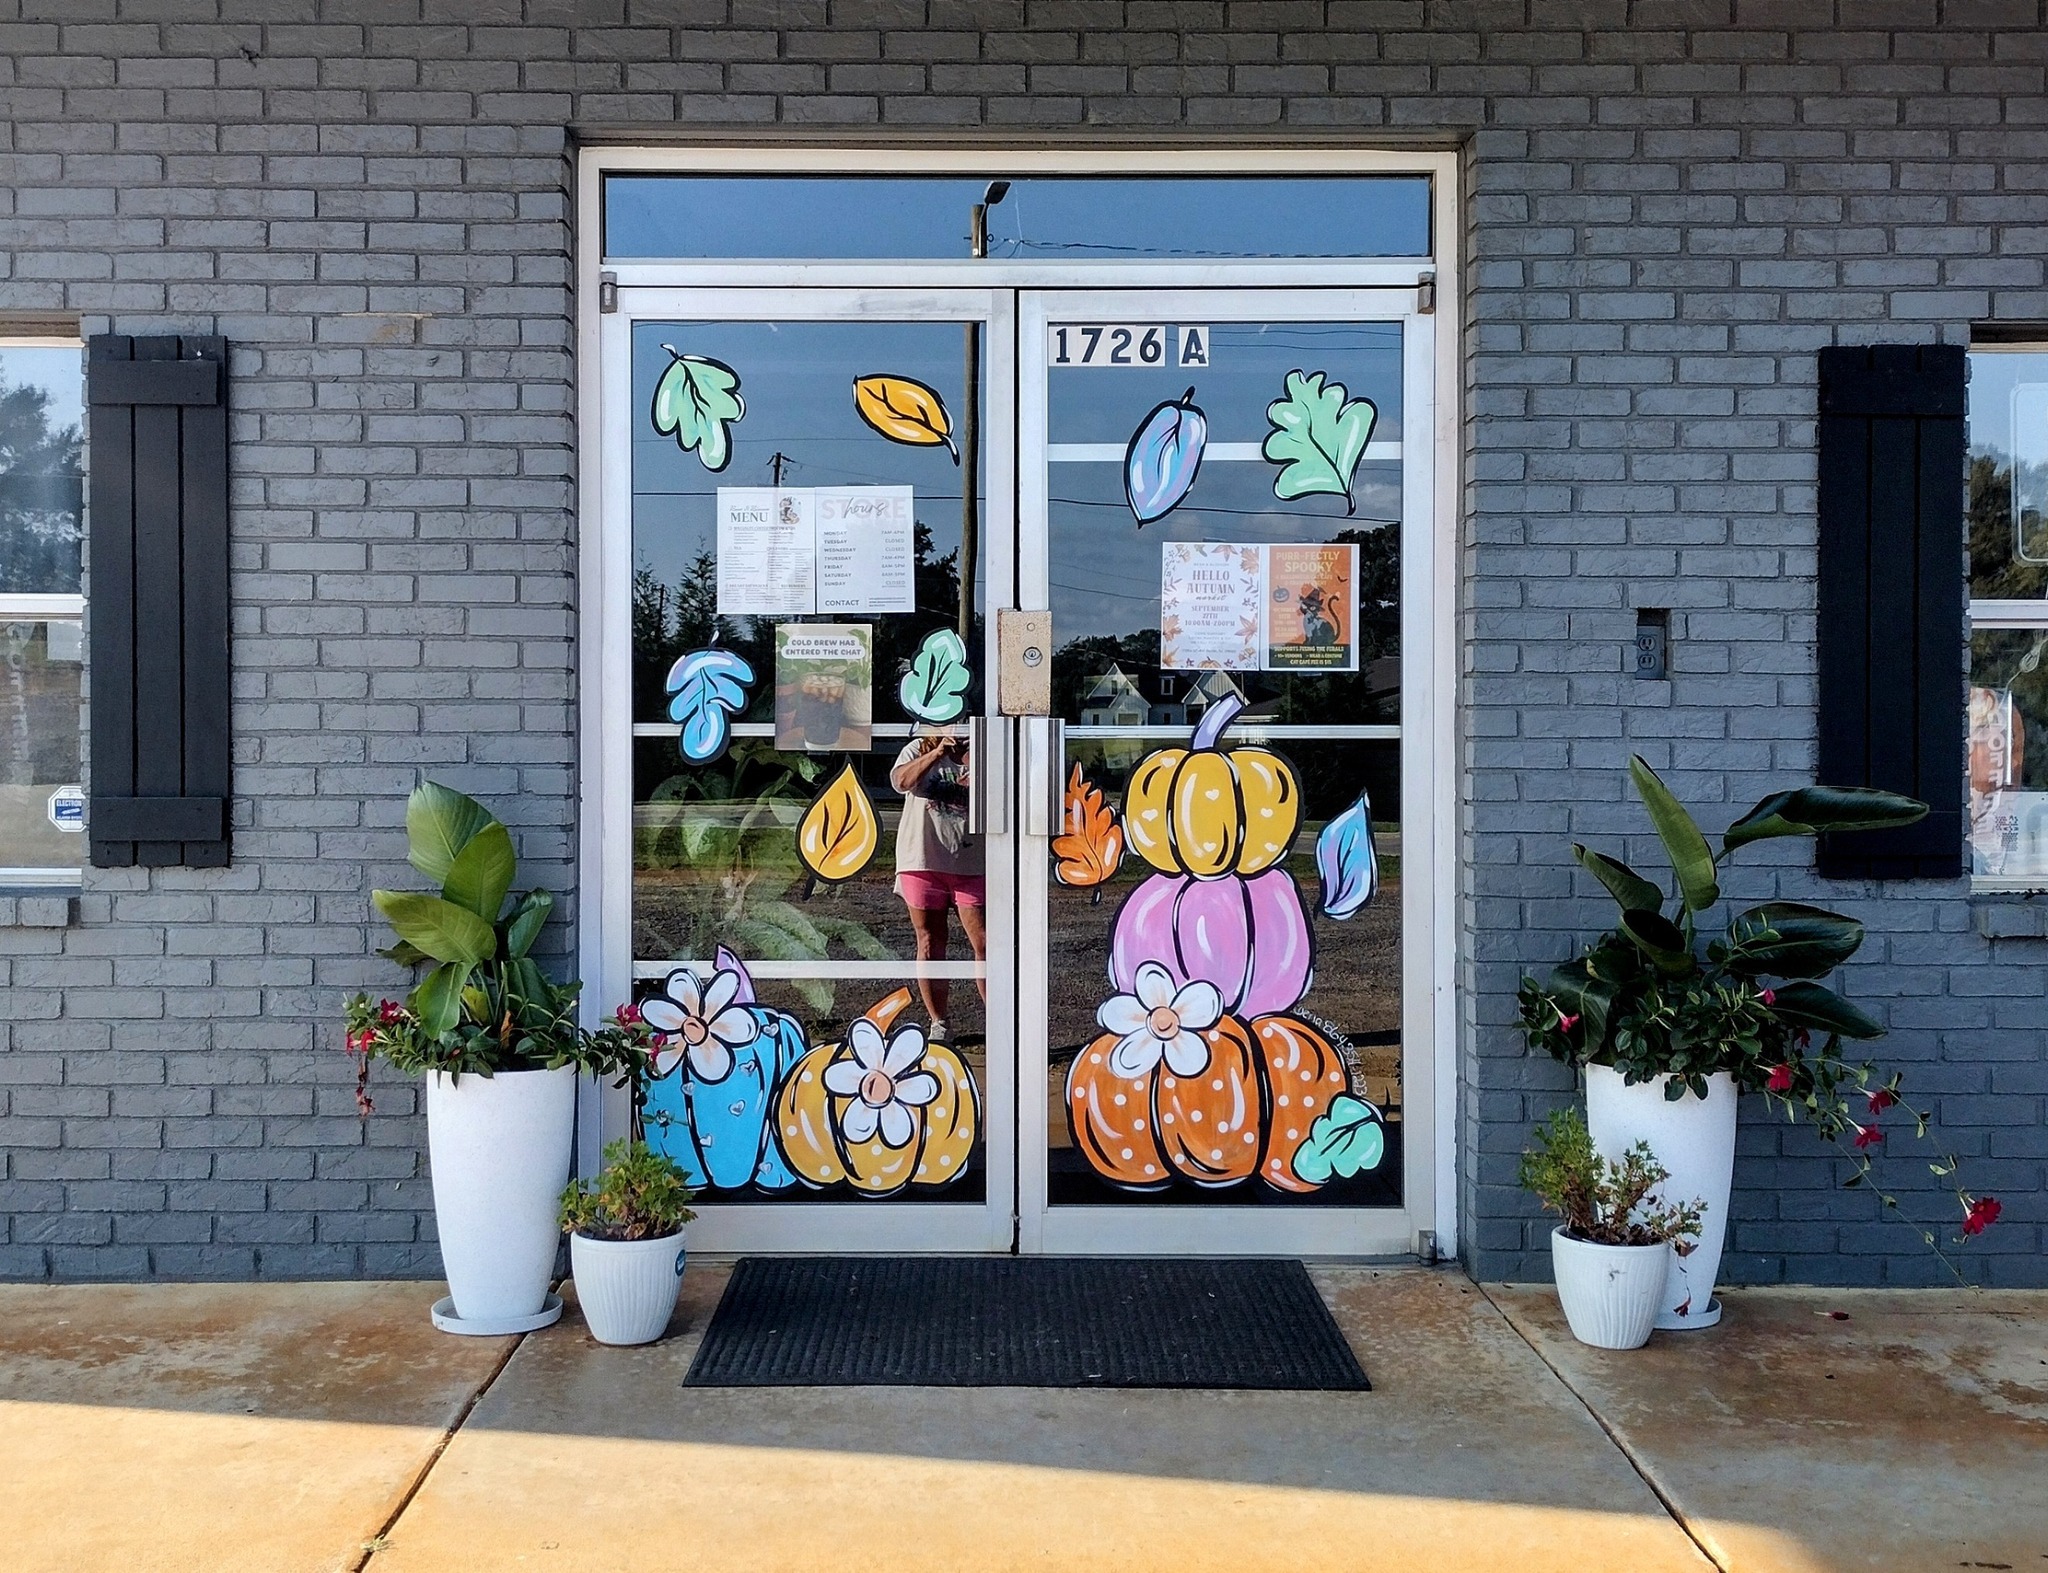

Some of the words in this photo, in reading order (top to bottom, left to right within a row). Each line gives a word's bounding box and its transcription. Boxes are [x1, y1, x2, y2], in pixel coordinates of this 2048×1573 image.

[1055, 327, 1162, 364] 1726
[1181, 328, 1207, 365] A
[821, 496, 907, 520] STORE
[843, 497, 887, 519] hours
[730, 511, 768, 523] MENU
[1284, 561, 1334, 573] SPOOKY
[1192, 570, 1230, 581] HELLO
[1186, 583, 1236, 594] AUTUMN
[785, 648, 820, 656] ENTERED
[822, 648, 839, 656] THE
[840, 648, 862, 656] CHAT
[56, 799, 82, 807] ELECTRON
